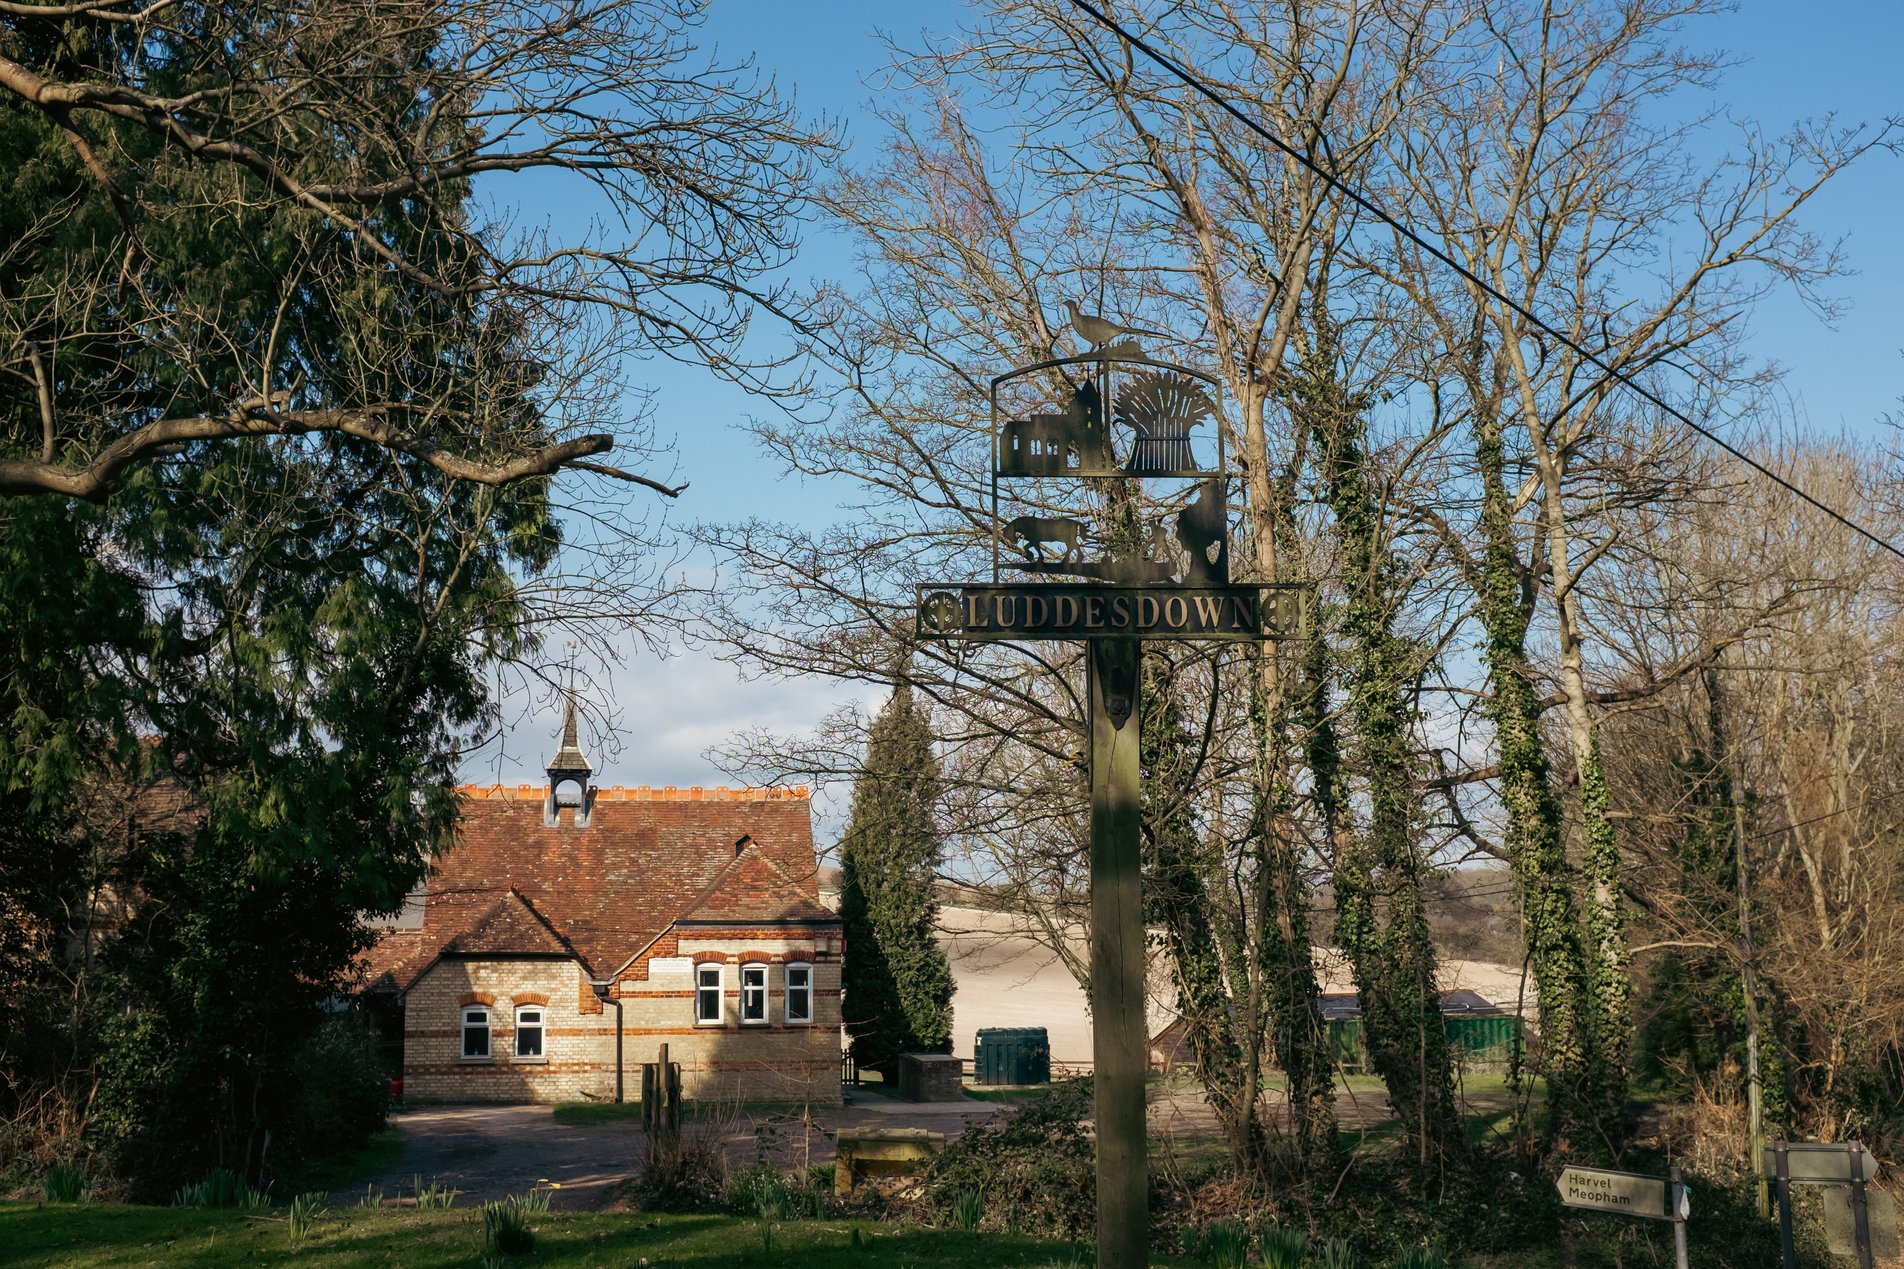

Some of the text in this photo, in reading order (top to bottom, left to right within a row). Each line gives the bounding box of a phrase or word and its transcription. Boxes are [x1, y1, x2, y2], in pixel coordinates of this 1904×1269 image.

[966, 595, 1255, 627] LUDDESDOWN
[1569, 1174, 1611, 1188] Harvel
[1569, 1187, 1630, 1204] Meopham
